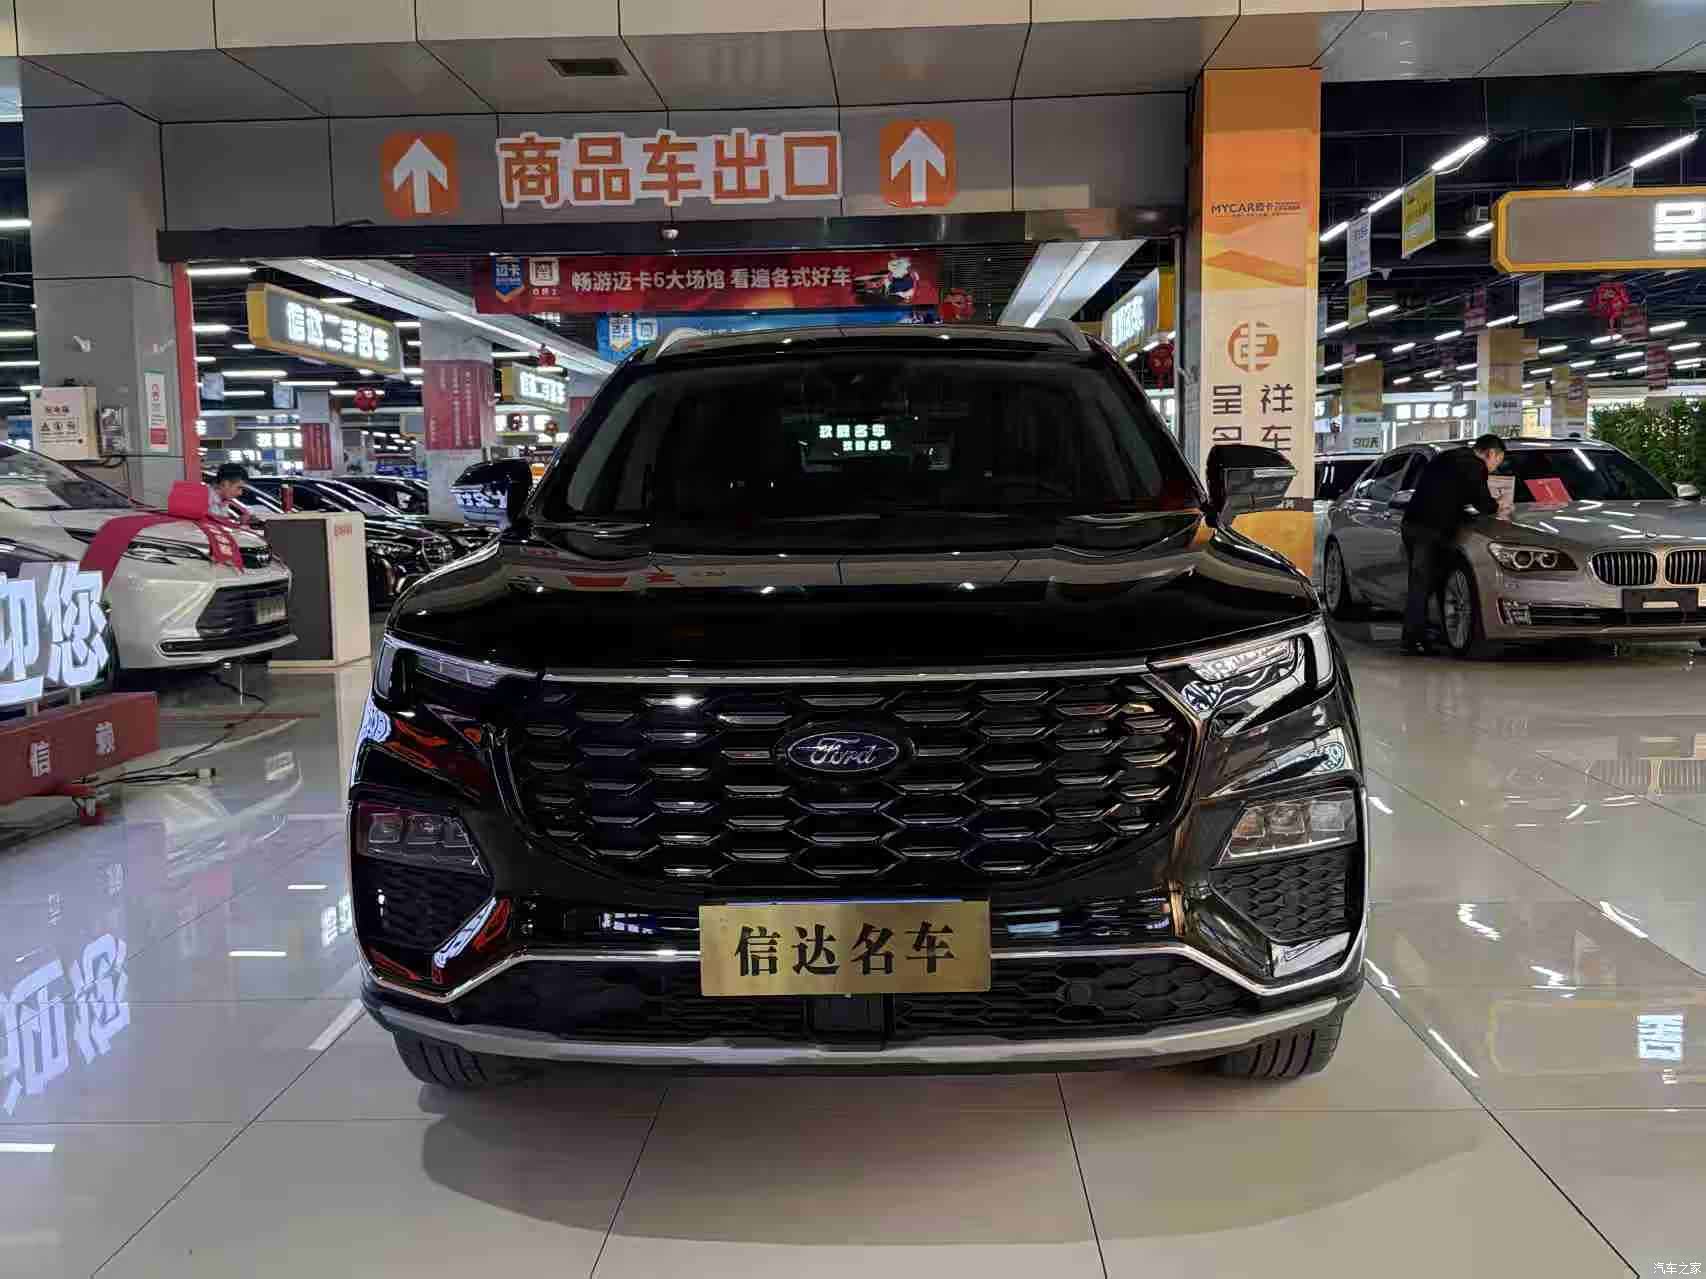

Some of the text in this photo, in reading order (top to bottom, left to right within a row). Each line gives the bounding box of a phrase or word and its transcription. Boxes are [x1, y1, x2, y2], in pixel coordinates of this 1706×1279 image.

[496, 131, 841, 206] 商品车出口
[731, 266, 851, 288] 看遍各式好车
[1212, 384, 1293, 415] 呈祥
[805, 737, 879, 765] Ford
[734, 921, 954, 976] 信达名车
